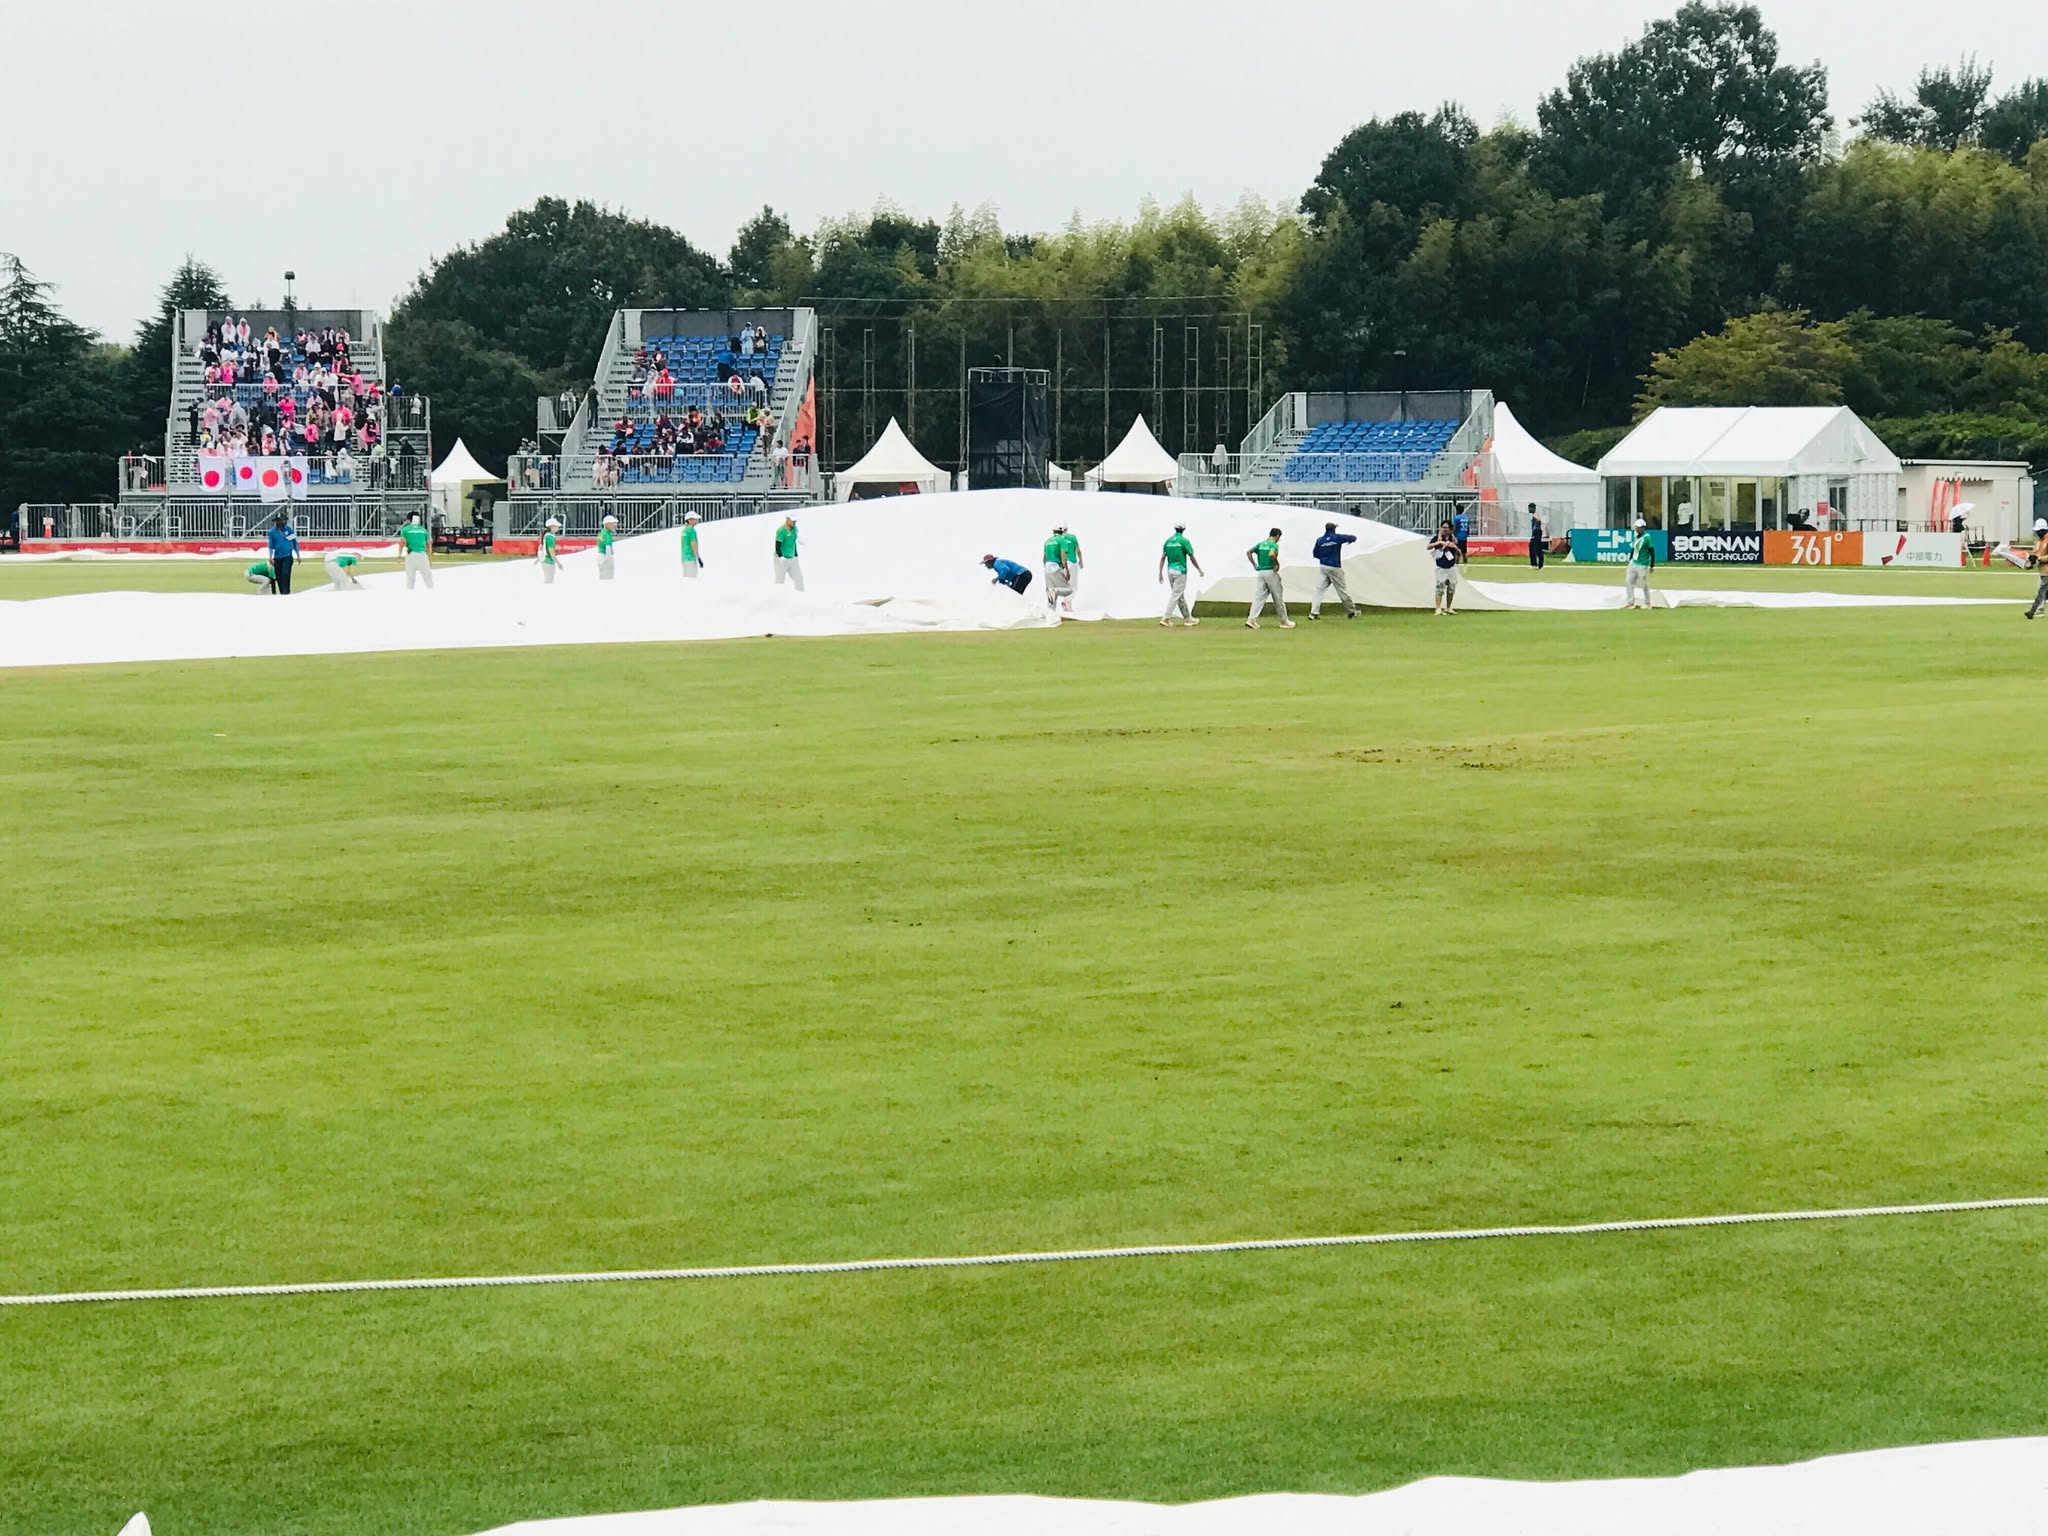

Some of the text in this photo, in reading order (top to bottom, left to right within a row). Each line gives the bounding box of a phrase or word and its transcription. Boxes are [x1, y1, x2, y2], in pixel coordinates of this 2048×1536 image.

[1672, 535, 1760, 552] BORNAN
[1674, 552, 1760, 561] SPORTS TECHNOLOGY
